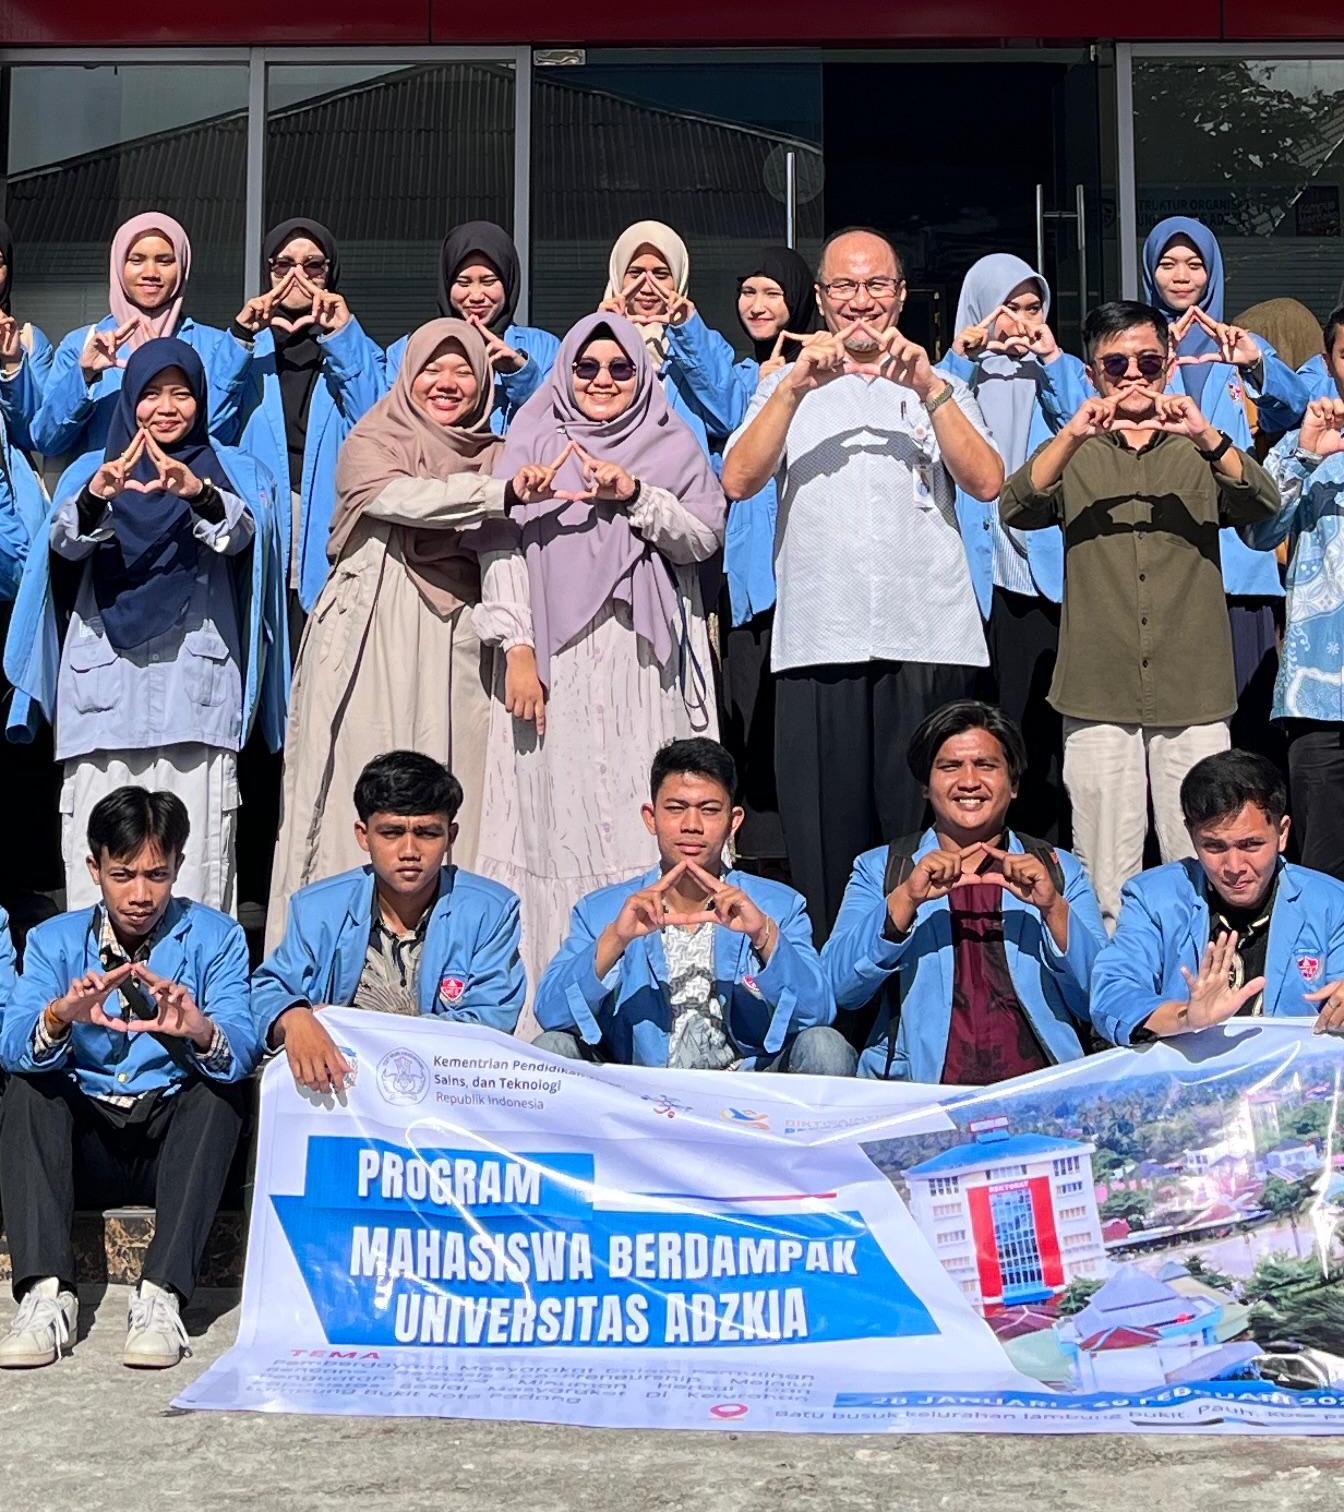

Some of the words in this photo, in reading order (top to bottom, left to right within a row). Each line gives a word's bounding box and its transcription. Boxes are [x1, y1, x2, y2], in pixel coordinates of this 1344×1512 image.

[1137, 199, 1188, 210] TRUKTUR
[433, 1055, 509, 1071] Kementrian
[433, 1074, 469, 1088] Sains,
[472, 1076, 496, 1088] dan
[499, 1077, 562, 1094] Teknologi
[435, 1091, 486, 1106] Republik
[488, 1095, 545, 1110] Indonesia
[358, 1148, 542, 1206] PROGRAM
[350, 1226, 594, 1283] MAHASISWA
[609, 1232, 857, 1280] BERDAMPAK
[394, 1291, 649, 1345] UNIVERSITAS
[665, 1287, 809, 1344] ADZKIA
[291, 1349, 380, 1360] TEMA
[917, 1395, 1057, 1408] JANUARI
